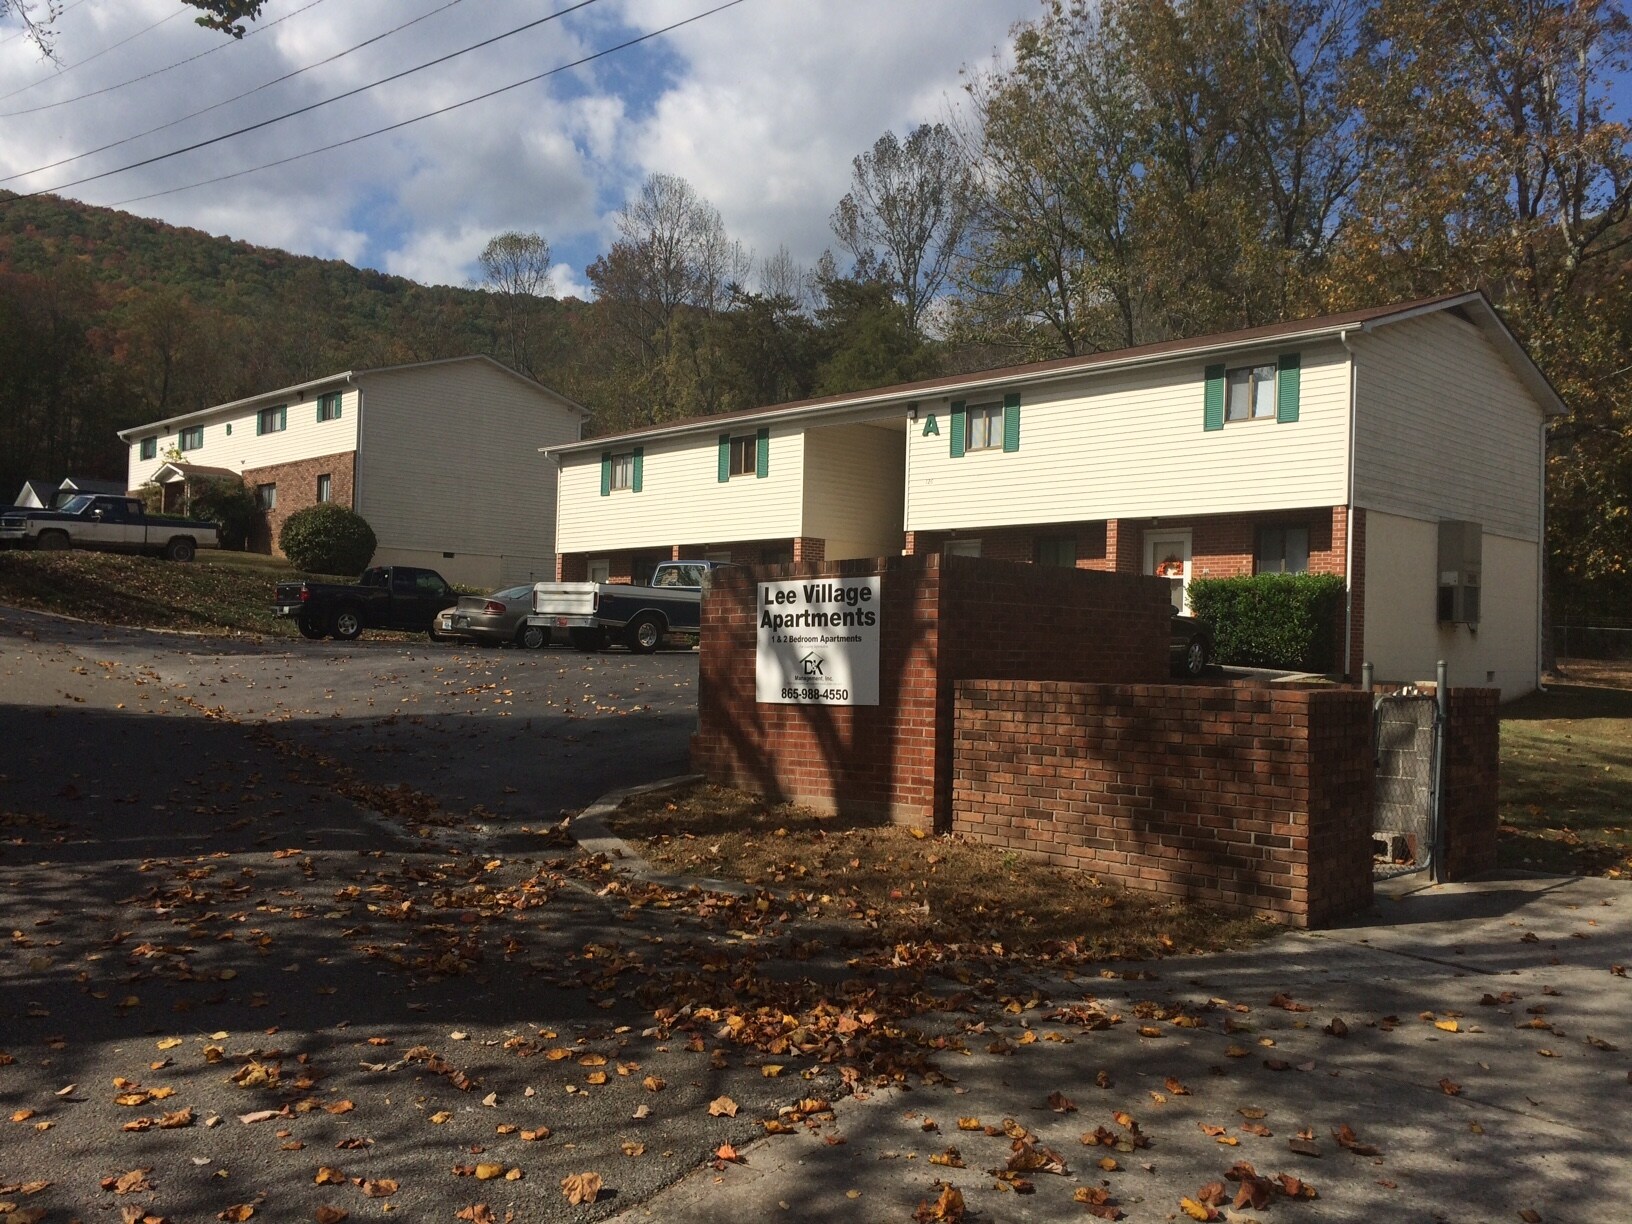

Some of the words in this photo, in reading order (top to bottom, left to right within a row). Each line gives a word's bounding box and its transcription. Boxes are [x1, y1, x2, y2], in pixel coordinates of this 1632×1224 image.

[922, 414, 940, 437] A
[764, 586, 796, 606] Lee
[802, 583, 872, 607] Village
[760, 607, 876, 632] Apartments
[777, 635, 782, 643] &
[783, 635, 788, 643] 2
[789, 635, 819, 643] Bedroom
[820, 634, 862, 646] Apartments
[781, 687, 849, 701] 865-988-4550
